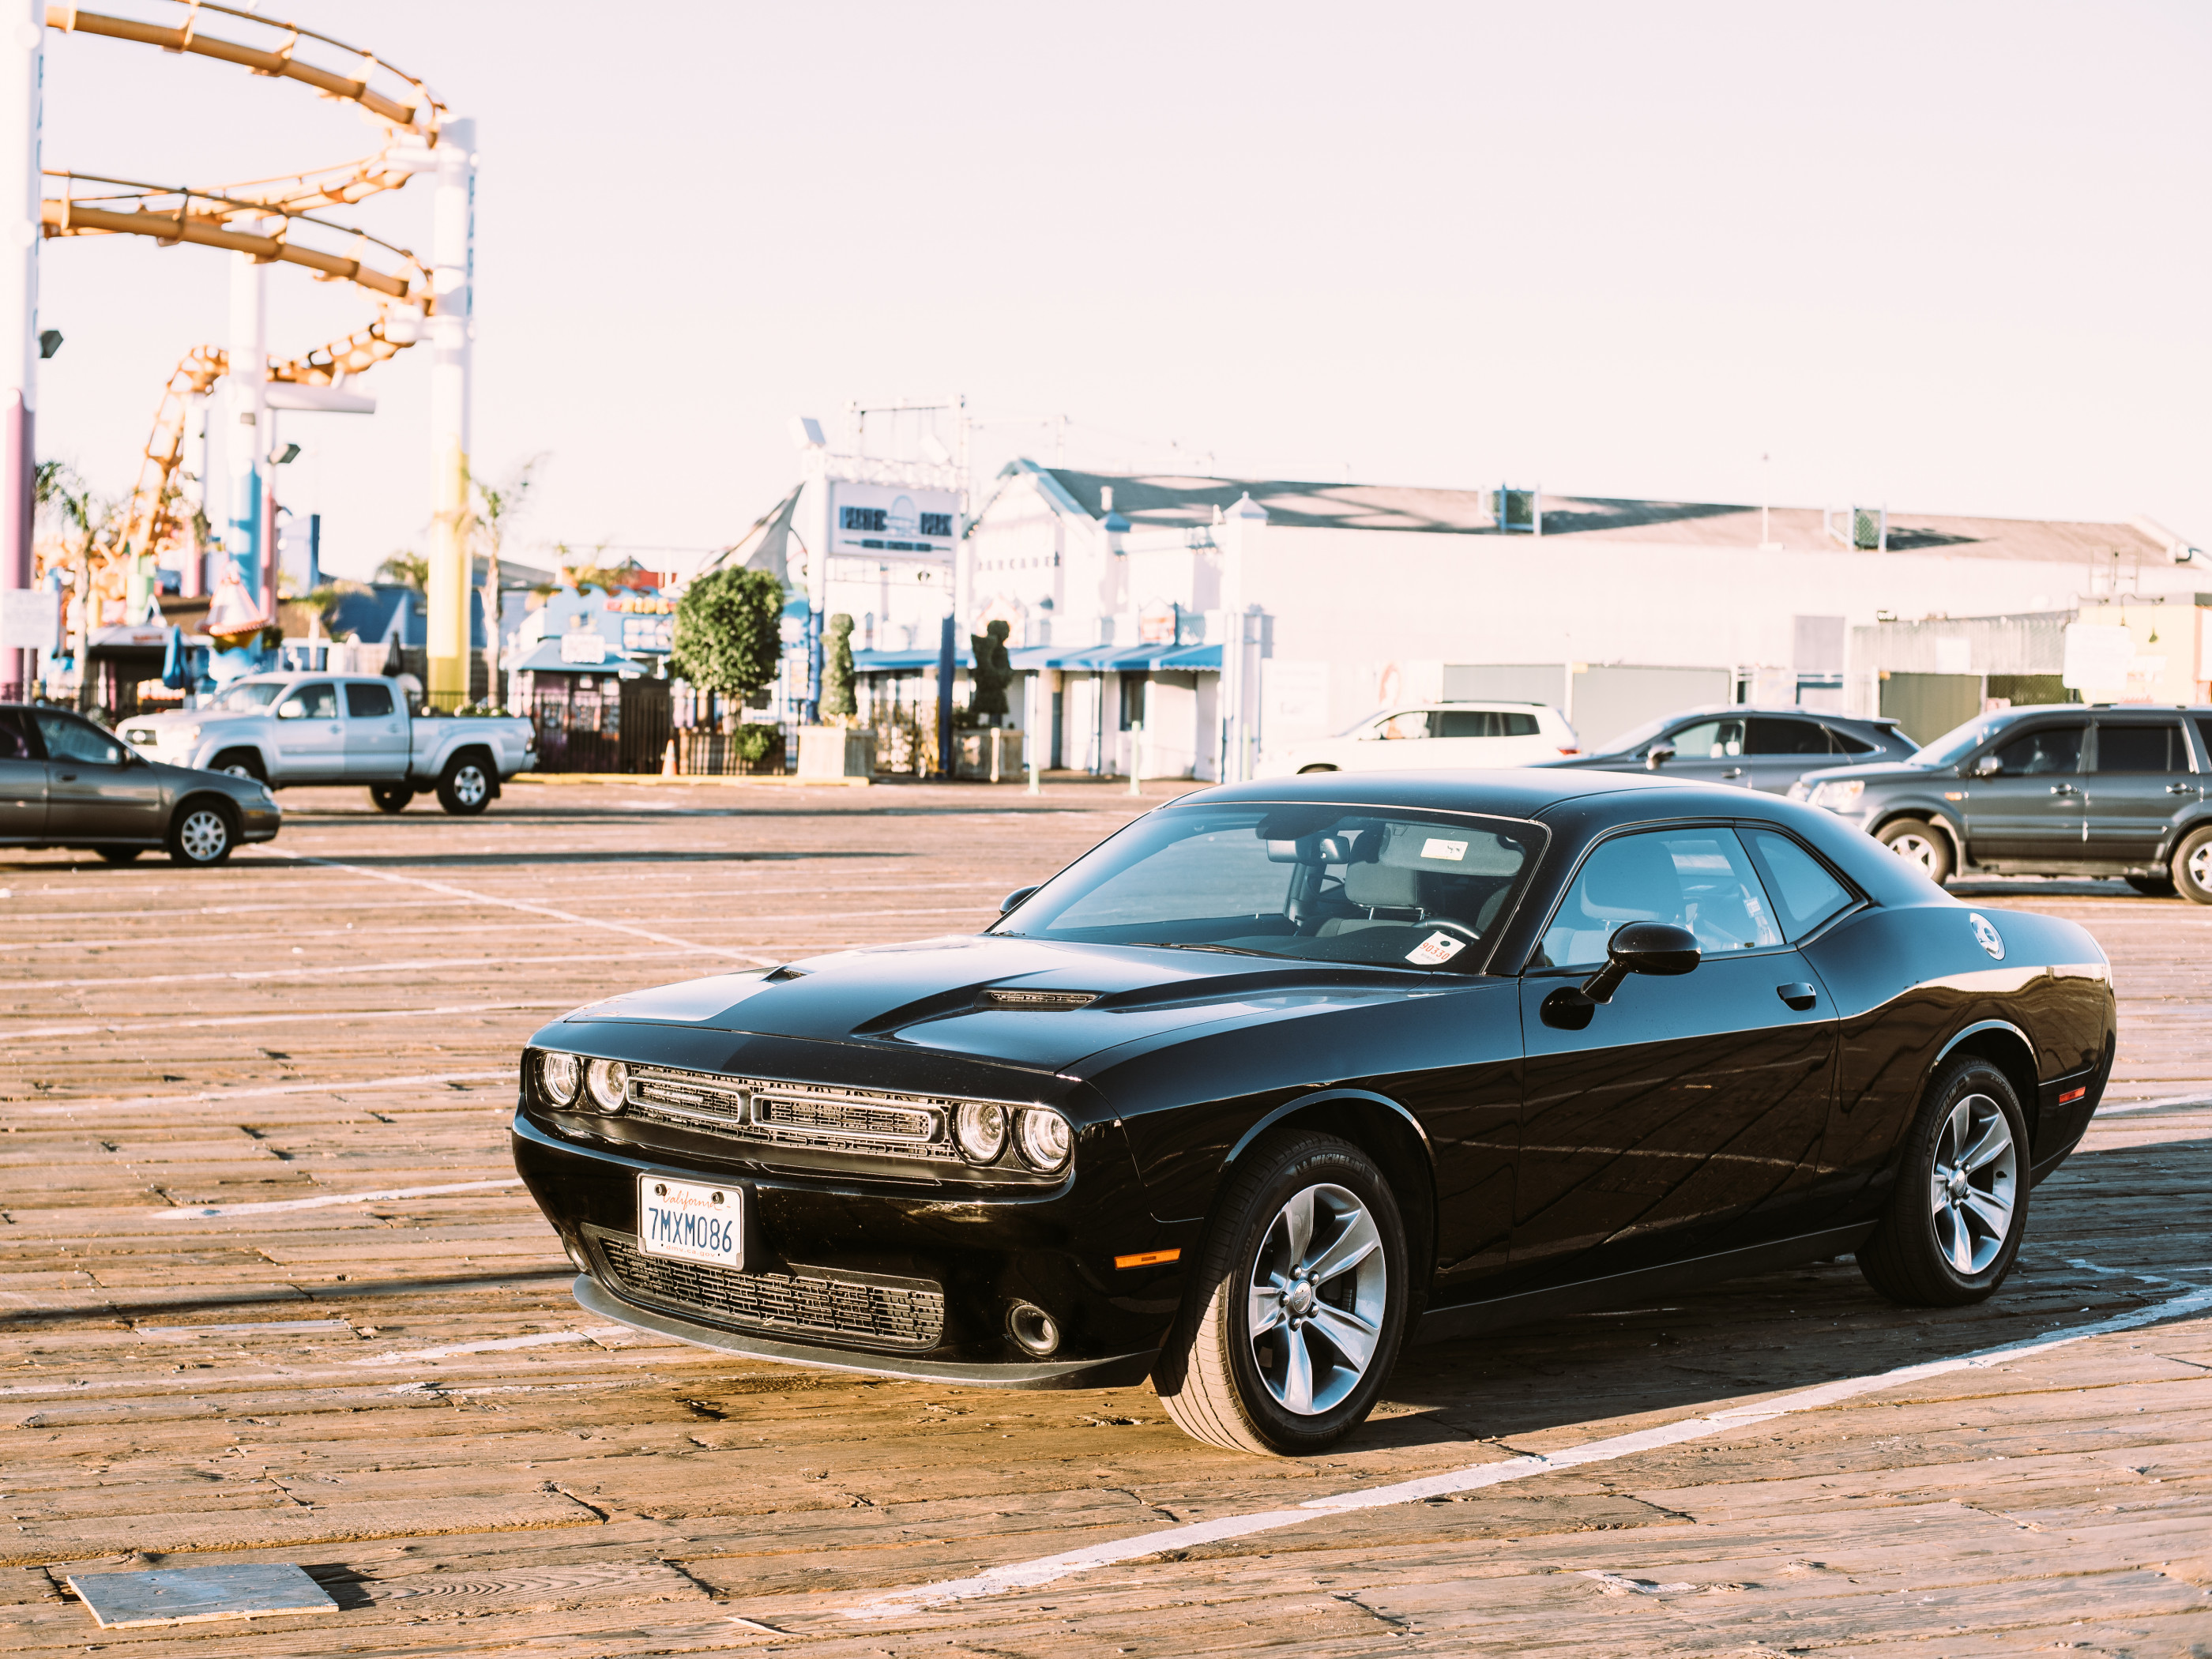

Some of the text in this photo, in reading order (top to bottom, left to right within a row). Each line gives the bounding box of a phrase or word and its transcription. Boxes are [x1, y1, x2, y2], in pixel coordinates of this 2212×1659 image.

[1420, 942, 1450, 961] 90330
[1932, 1086, 1958, 1139] MICHELIN
[1311, 1153, 1363, 1170] MICHELIN
[662, 1187, 723, 1211] California
[649, 1207, 732, 1252] 7MXM086
[665, 1244, 716, 1258] dmv.ca.gov
